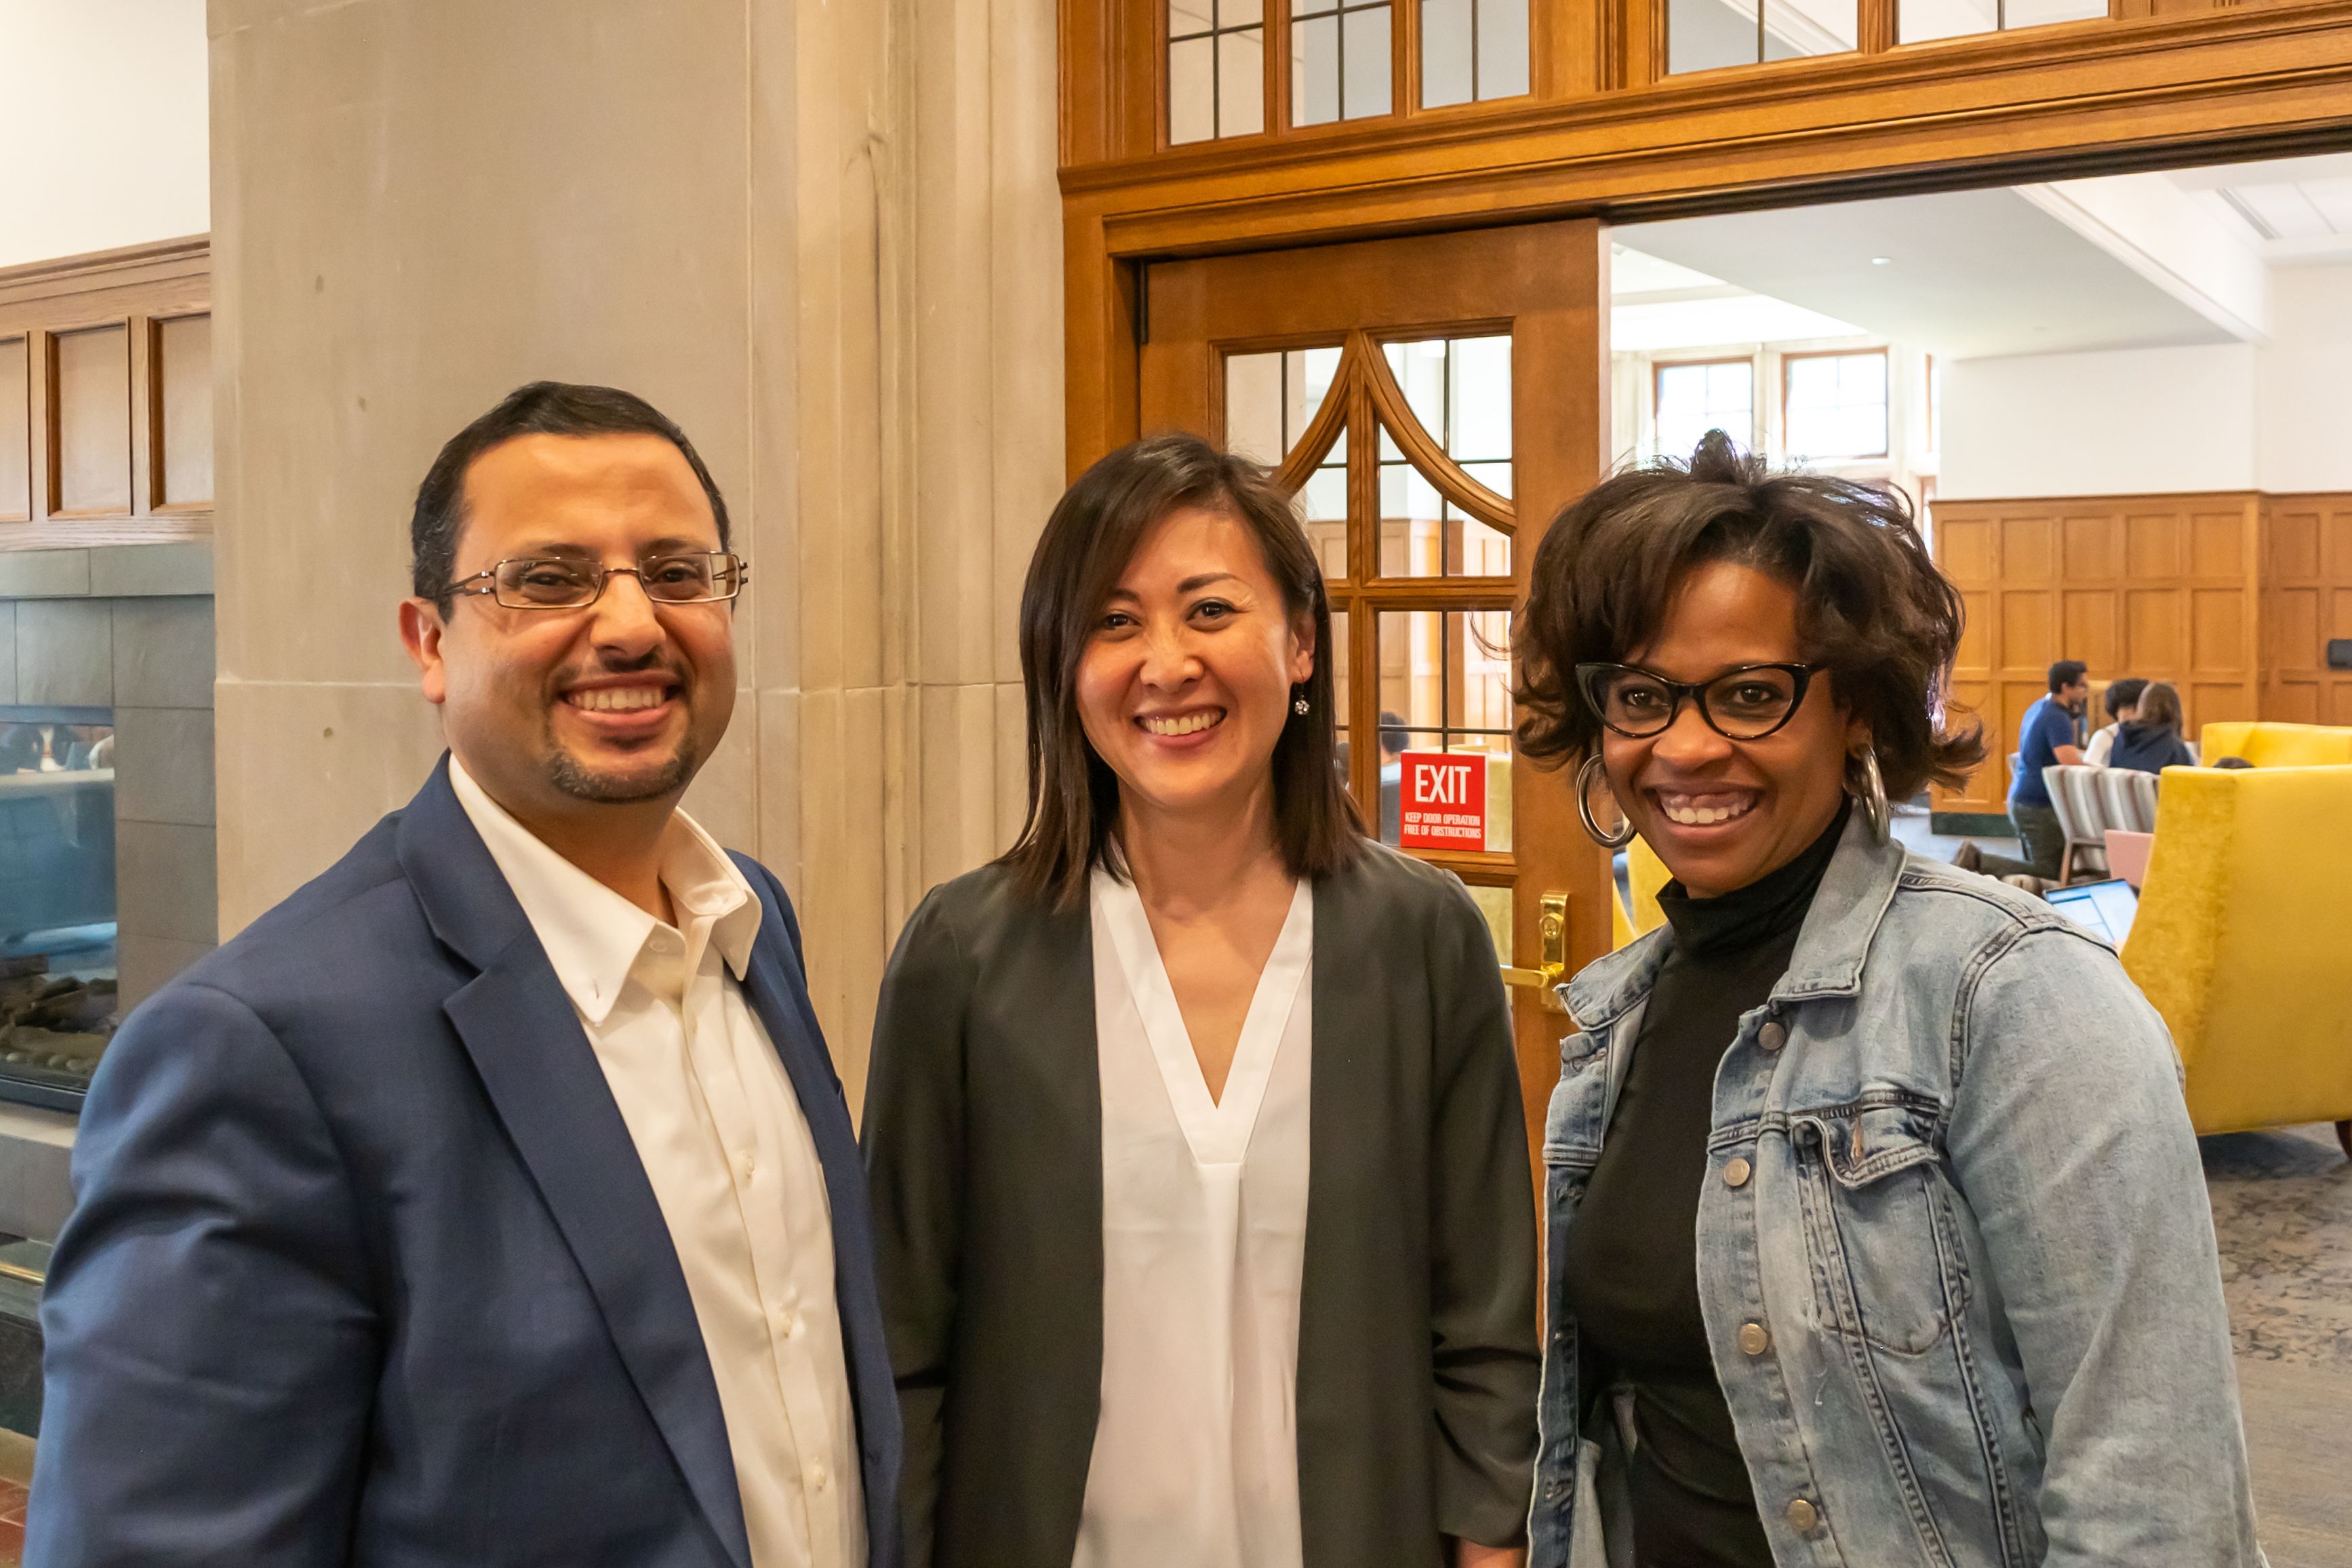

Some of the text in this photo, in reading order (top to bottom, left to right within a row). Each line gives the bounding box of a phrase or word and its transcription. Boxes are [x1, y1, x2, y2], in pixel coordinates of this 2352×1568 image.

[1415, 764, 1472, 805] EXIT
[1405, 811, 1481, 826] KEEP DOOR OPERATION
[1404, 824, 1481, 839] FREE OF OBSTRUCTIONS
